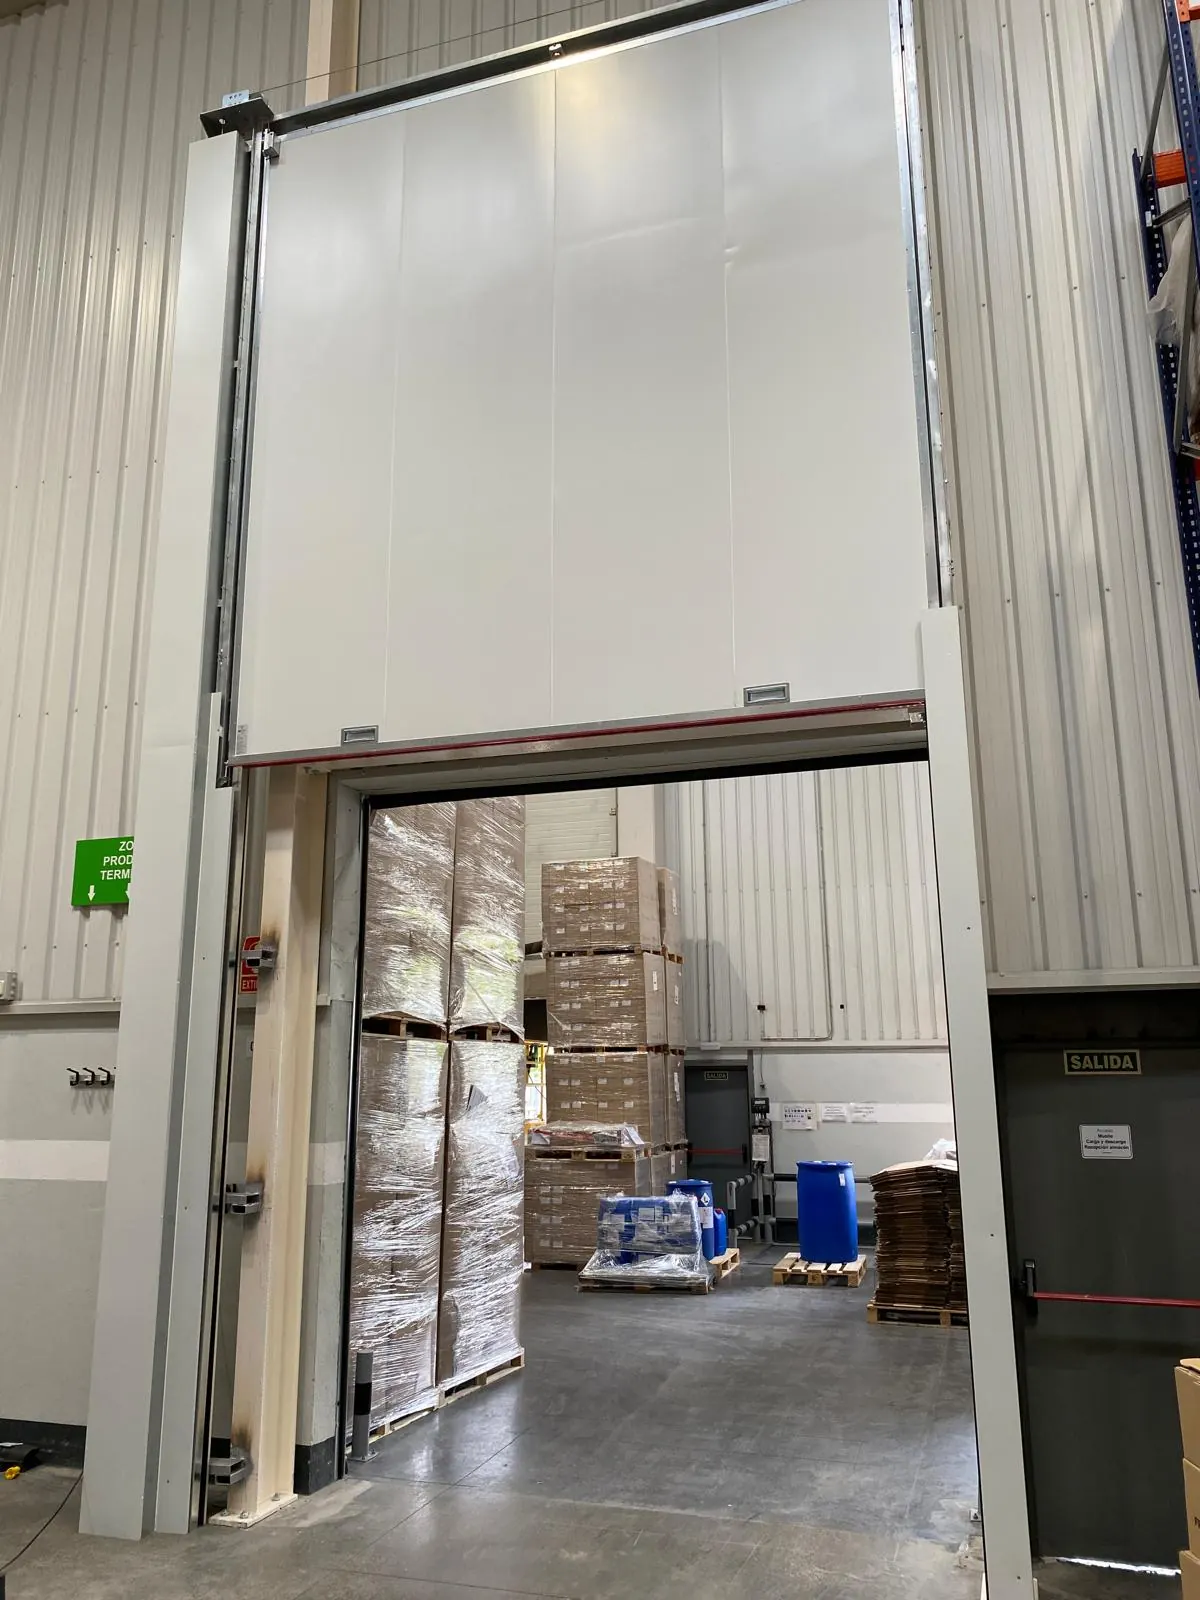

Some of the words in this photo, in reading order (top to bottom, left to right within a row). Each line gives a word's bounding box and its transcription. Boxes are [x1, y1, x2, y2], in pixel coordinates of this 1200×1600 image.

[118, 840, 134, 851] ZO
[103, 854, 133, 867] PROD
[1070, 1055, 1134, 1069] SALIDA
